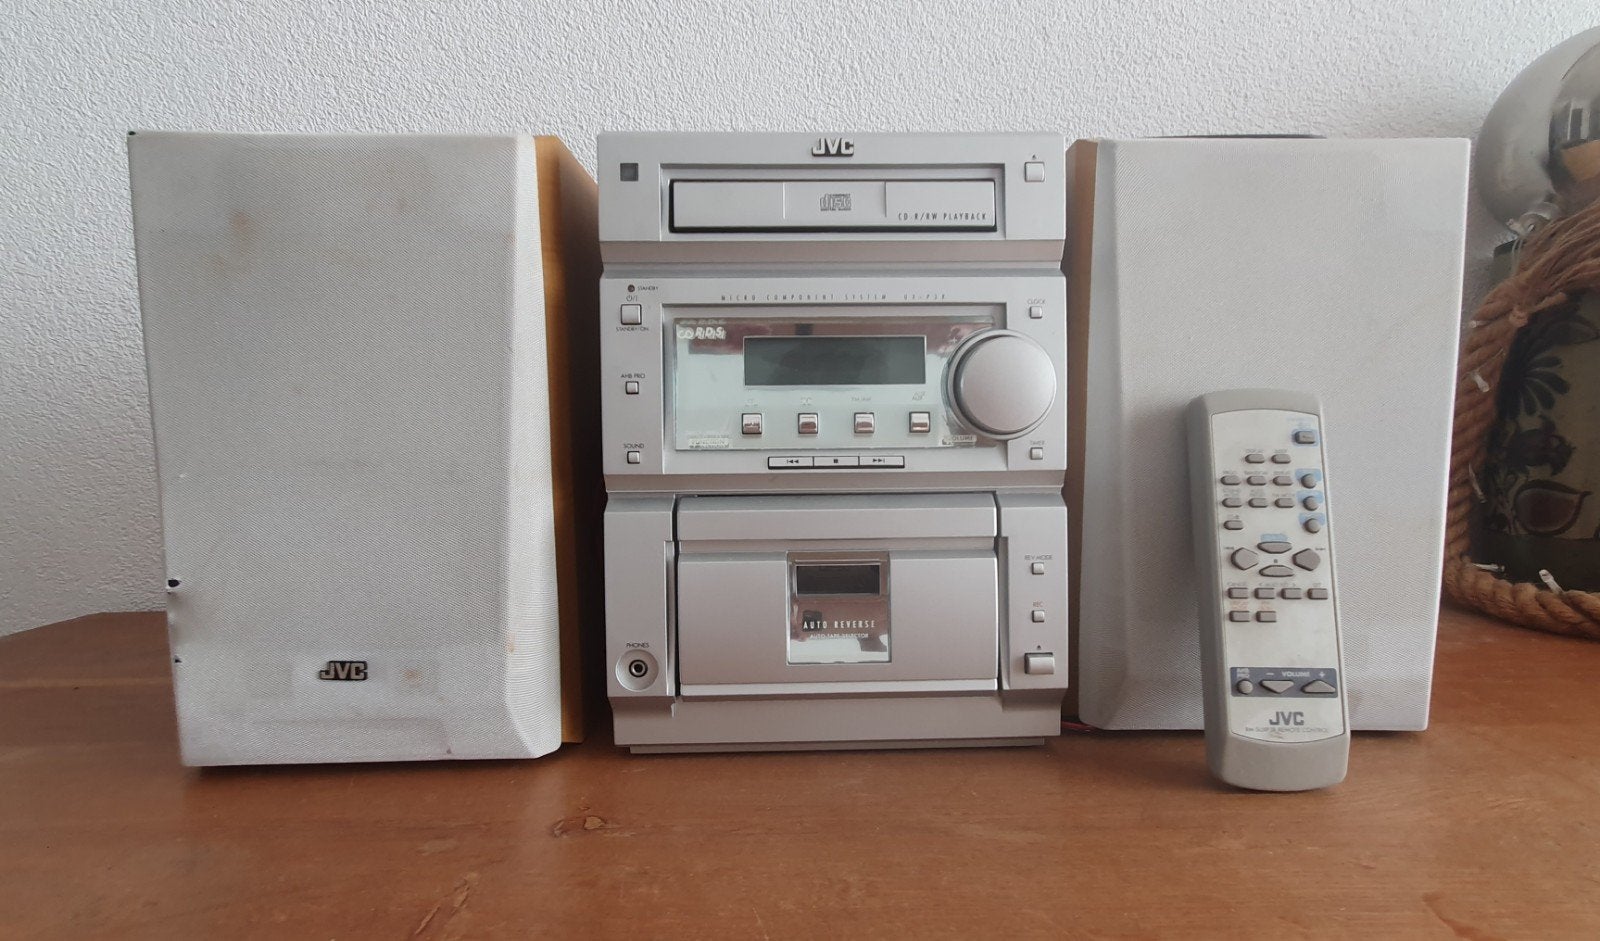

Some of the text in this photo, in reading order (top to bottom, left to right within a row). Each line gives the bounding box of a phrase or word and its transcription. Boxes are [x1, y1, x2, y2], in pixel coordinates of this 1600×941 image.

[812, 137, 854, 157] JVC
[943, 212, 986, 220] PLAYBACK
[803, 620, 876, 630] AUTO REVERSE
[319, 661, 368, 681] JVC
[1269, 711, 1305, 726] JVC
